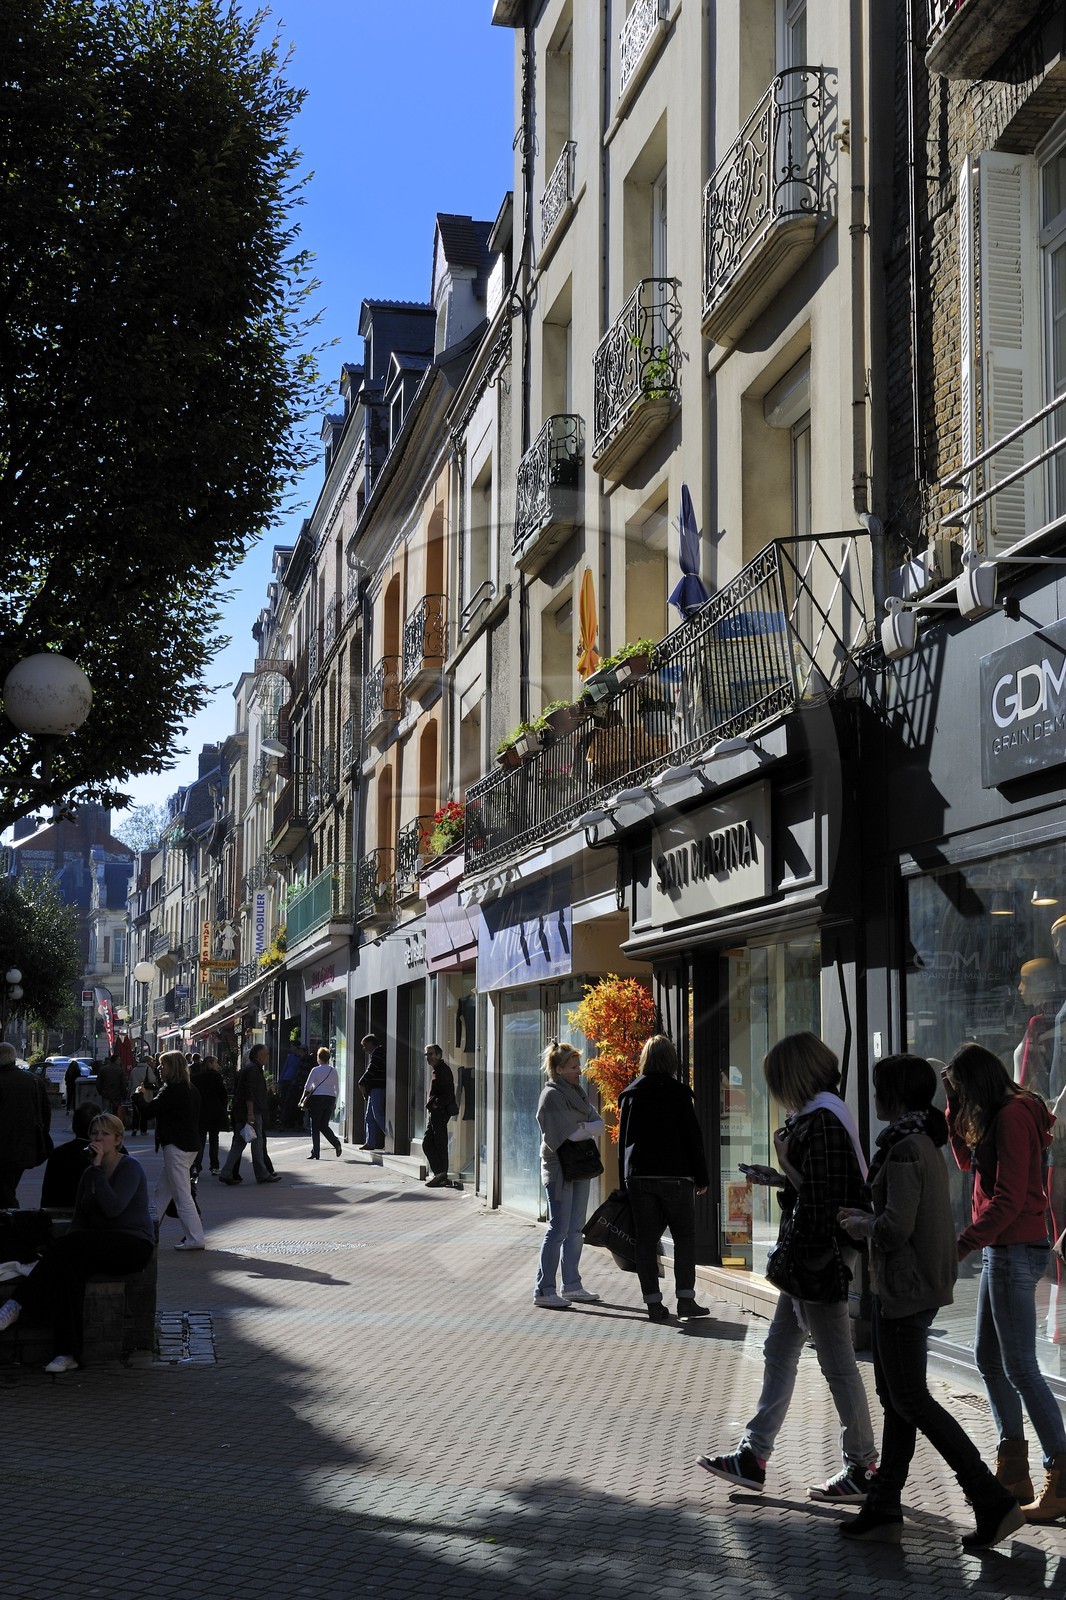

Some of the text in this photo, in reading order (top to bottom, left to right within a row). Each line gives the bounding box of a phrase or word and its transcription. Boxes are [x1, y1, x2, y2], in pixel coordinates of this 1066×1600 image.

[256, 660, 291, 671] BRUNET
[992, 656, 1066, 728] GDM
[992, 727, 1030, 755] GRAIN
[1033, 720, 1051, 741] DE
[657, 820, 758, 895] SAN MARINA
[201, 922, 210, 983] CAFE GRLL
[256, 893, 266, 954] IMMOBILIER
[913, 951, 980, 970] GDM
